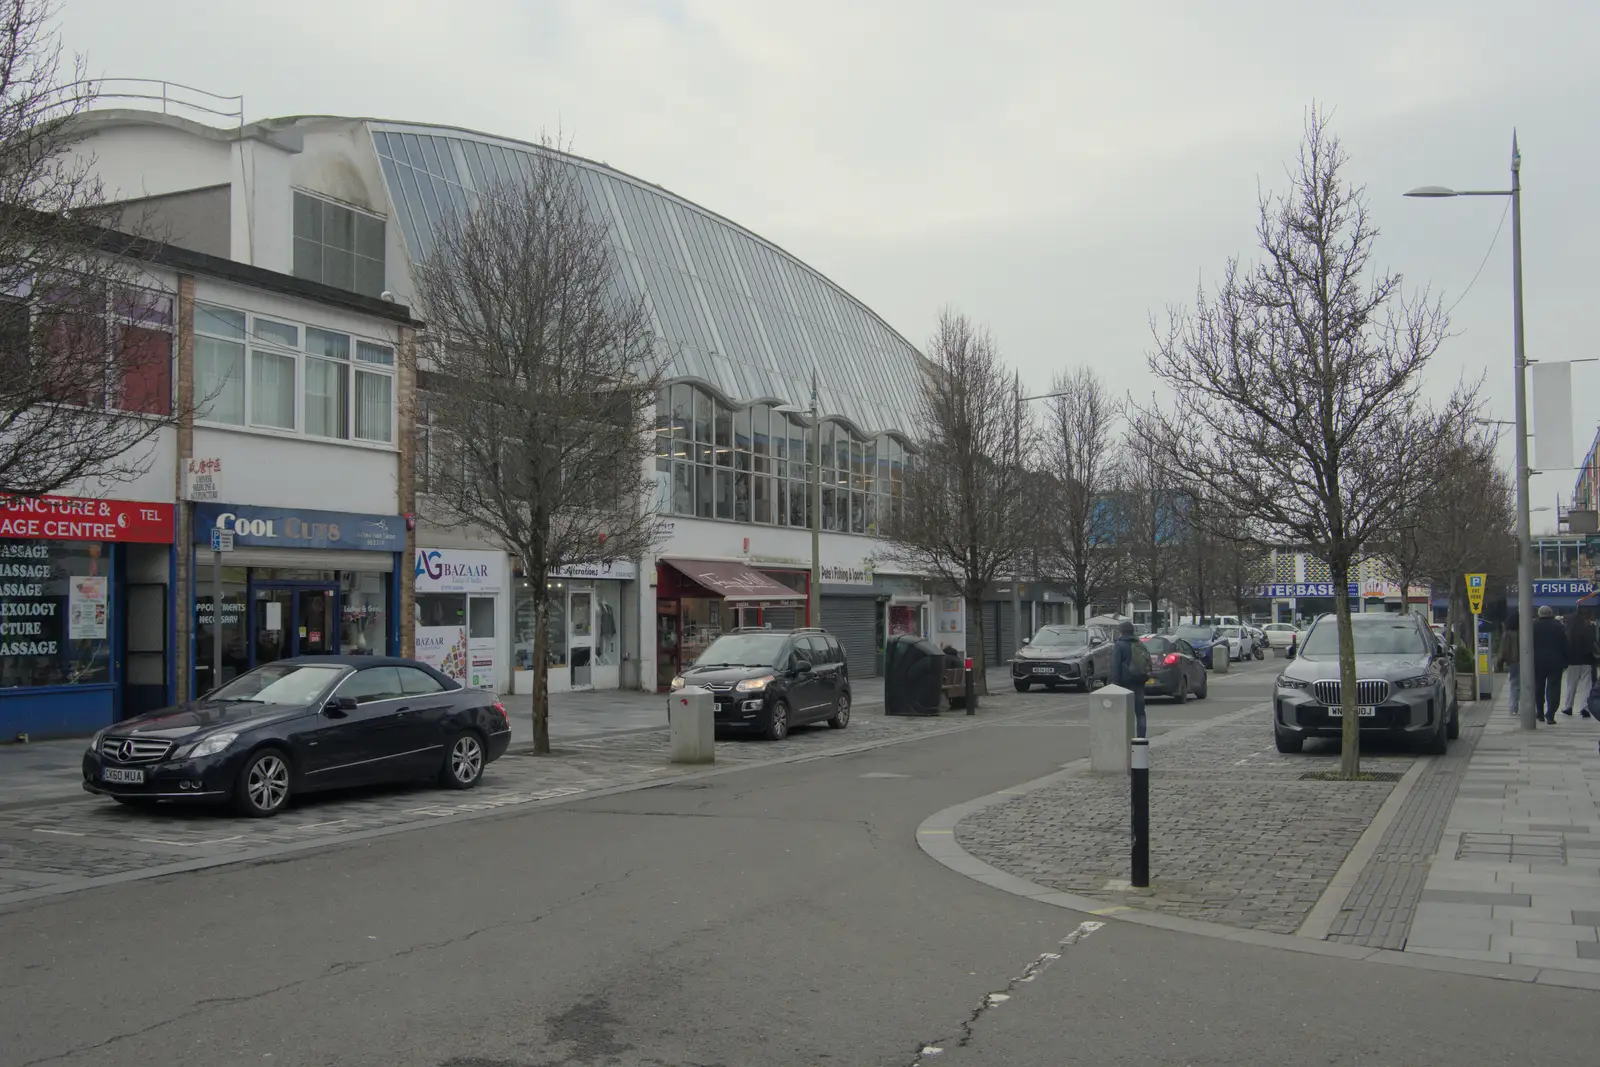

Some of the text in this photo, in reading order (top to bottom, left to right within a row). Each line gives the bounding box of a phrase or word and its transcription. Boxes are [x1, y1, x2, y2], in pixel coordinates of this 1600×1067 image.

[98, 502, 111, 517] &
[140, 508, 162, 521] TEL
[44, 520, 116, 538] CENTRE
[0, 545, 49, 558] ASSAGE
[415, 550, 488, 580] AG BAZAAR
[1472, 577, 1480, 587] P
[1541, 584, 1566, 593] FISH
[1570, 584, 1593, 593] BAR
[1244, 584, 1334, 596] UTERBASE
[0, 603, 56, 616] EXOLOGY
[199, 615, 238, 624] NECSARY
[415, 637, 444, 646] BAZAAR
